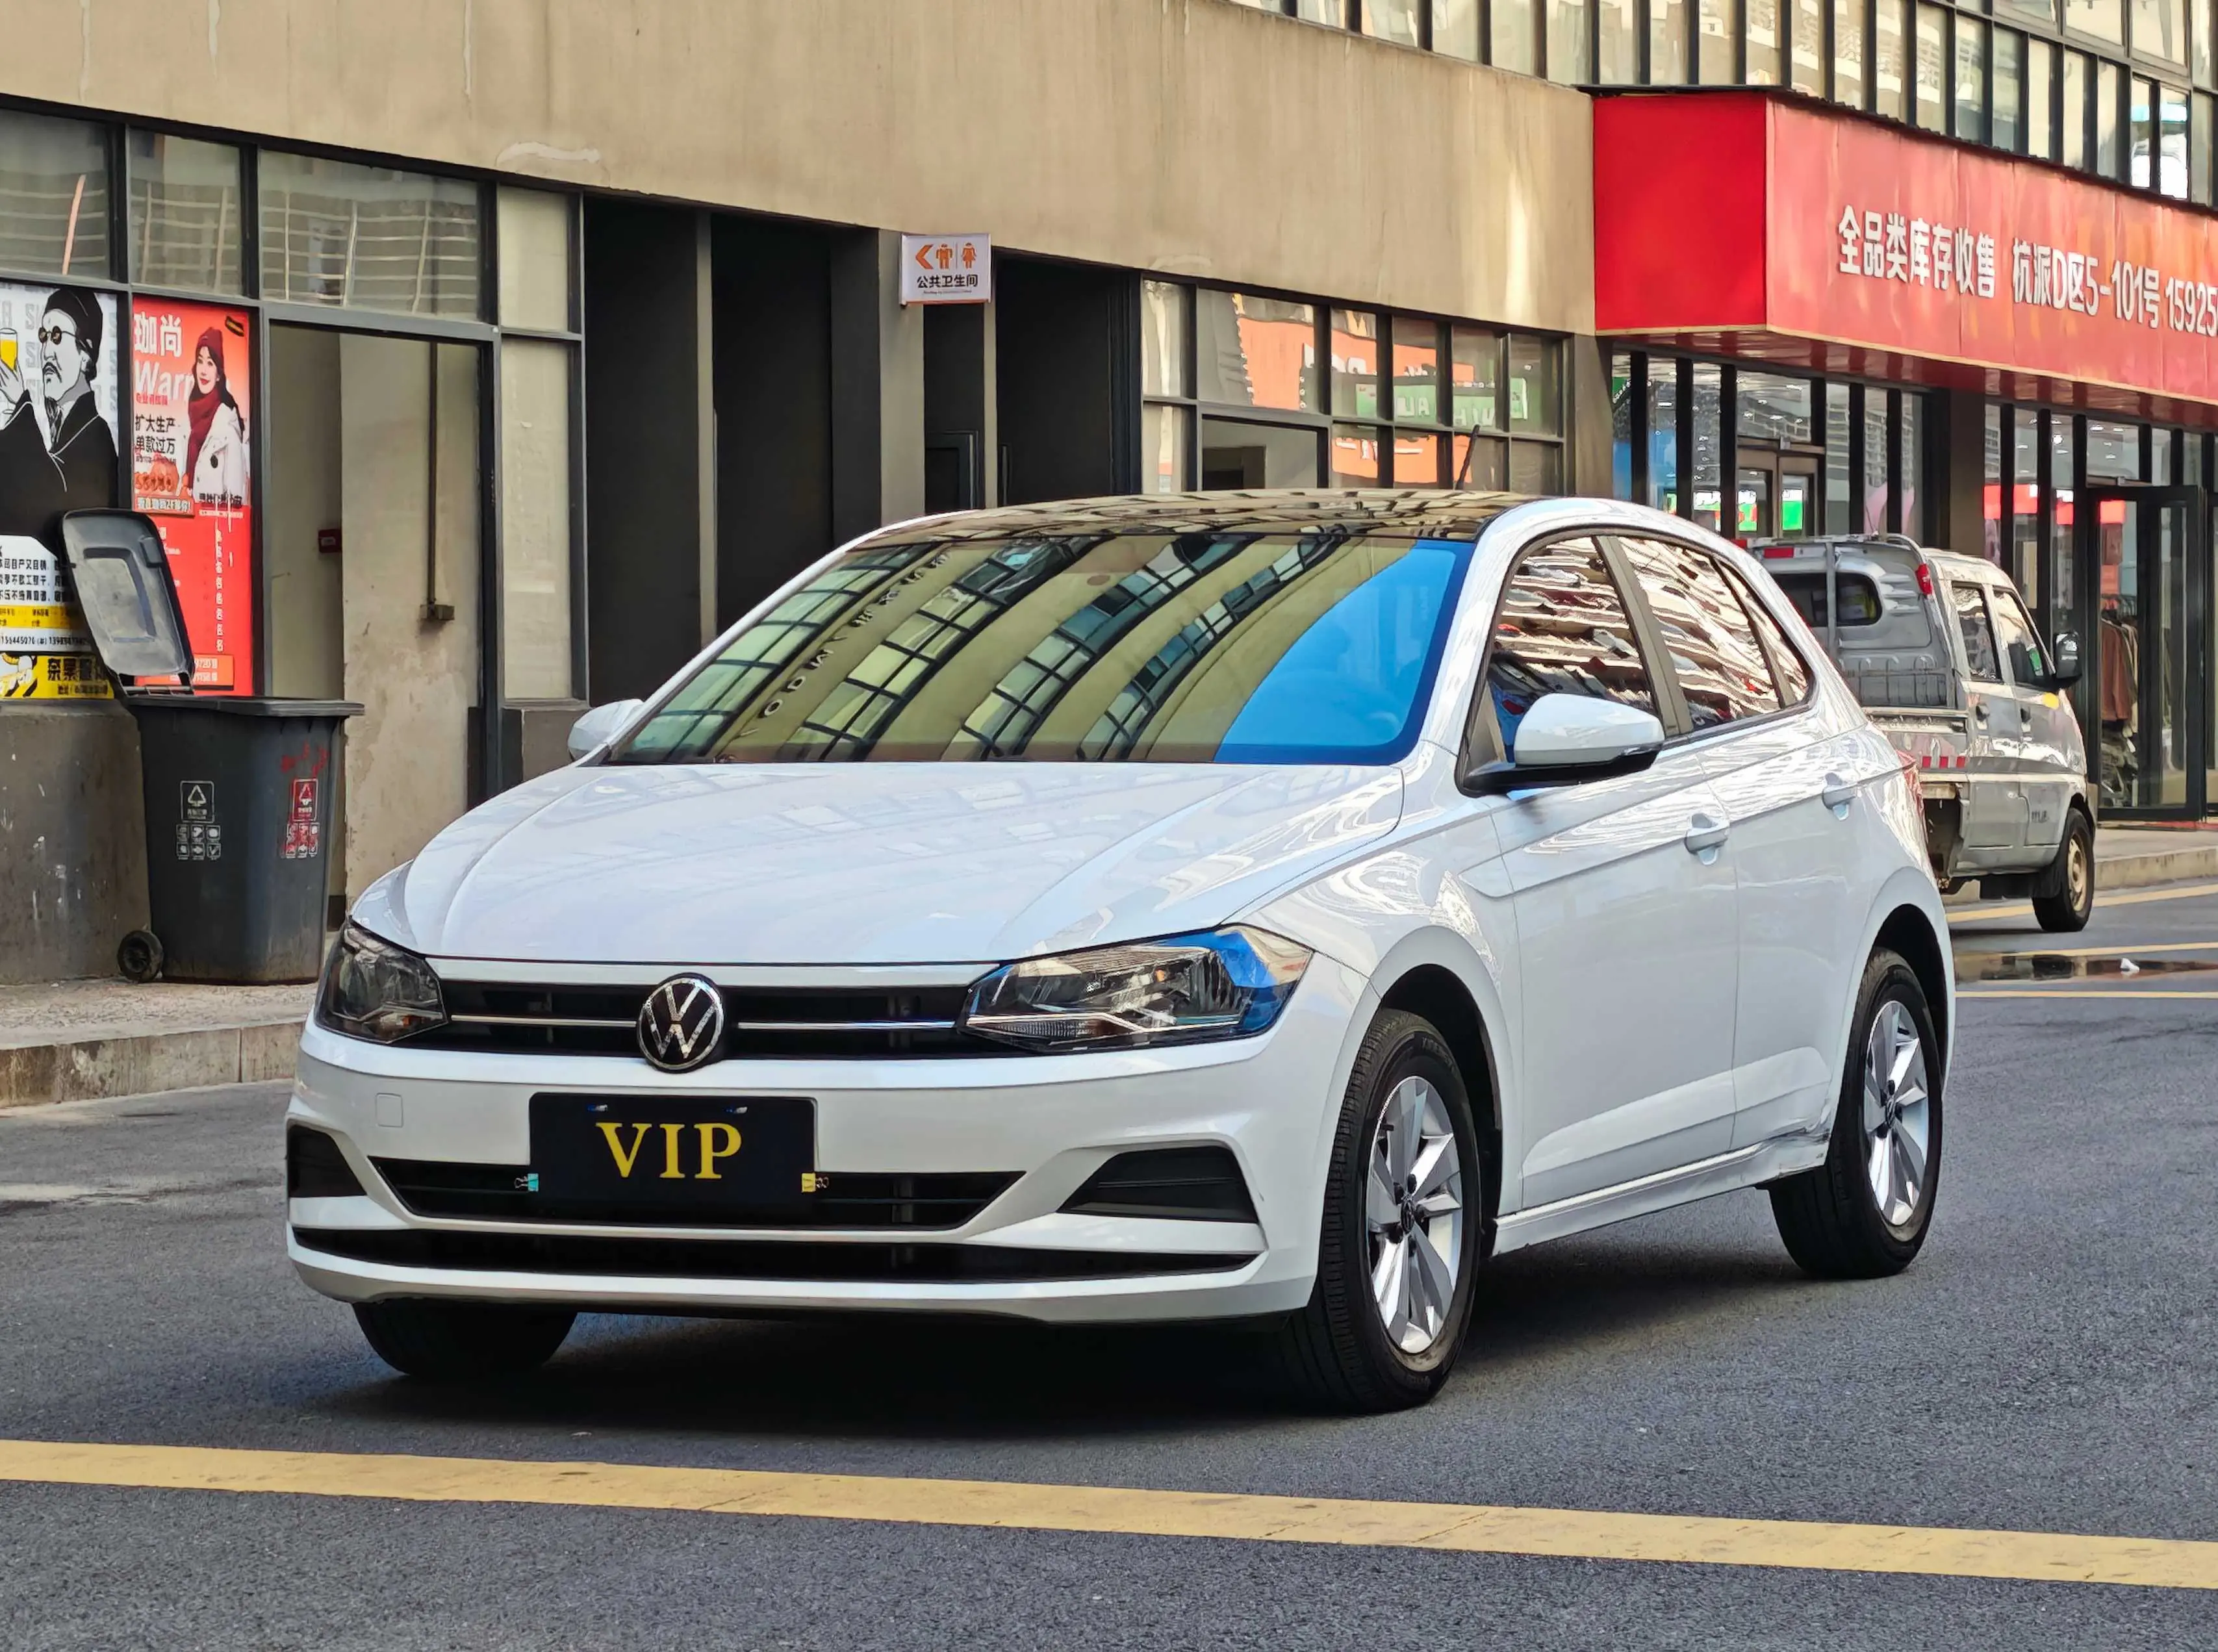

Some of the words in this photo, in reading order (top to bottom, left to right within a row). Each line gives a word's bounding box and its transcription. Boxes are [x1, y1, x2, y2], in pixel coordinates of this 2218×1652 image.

[1837, 205, 1996, 299] 全品类库存收售
[2012, 237, 2161, 329] 杭派D区5-101号
[916, 273, 979, 288] 公共卫生间
[135, 413, 176, 433] 扩大生产
[135, 435, 176, 454] 单款过万
[595, 1121, 743, 1180] VIP
